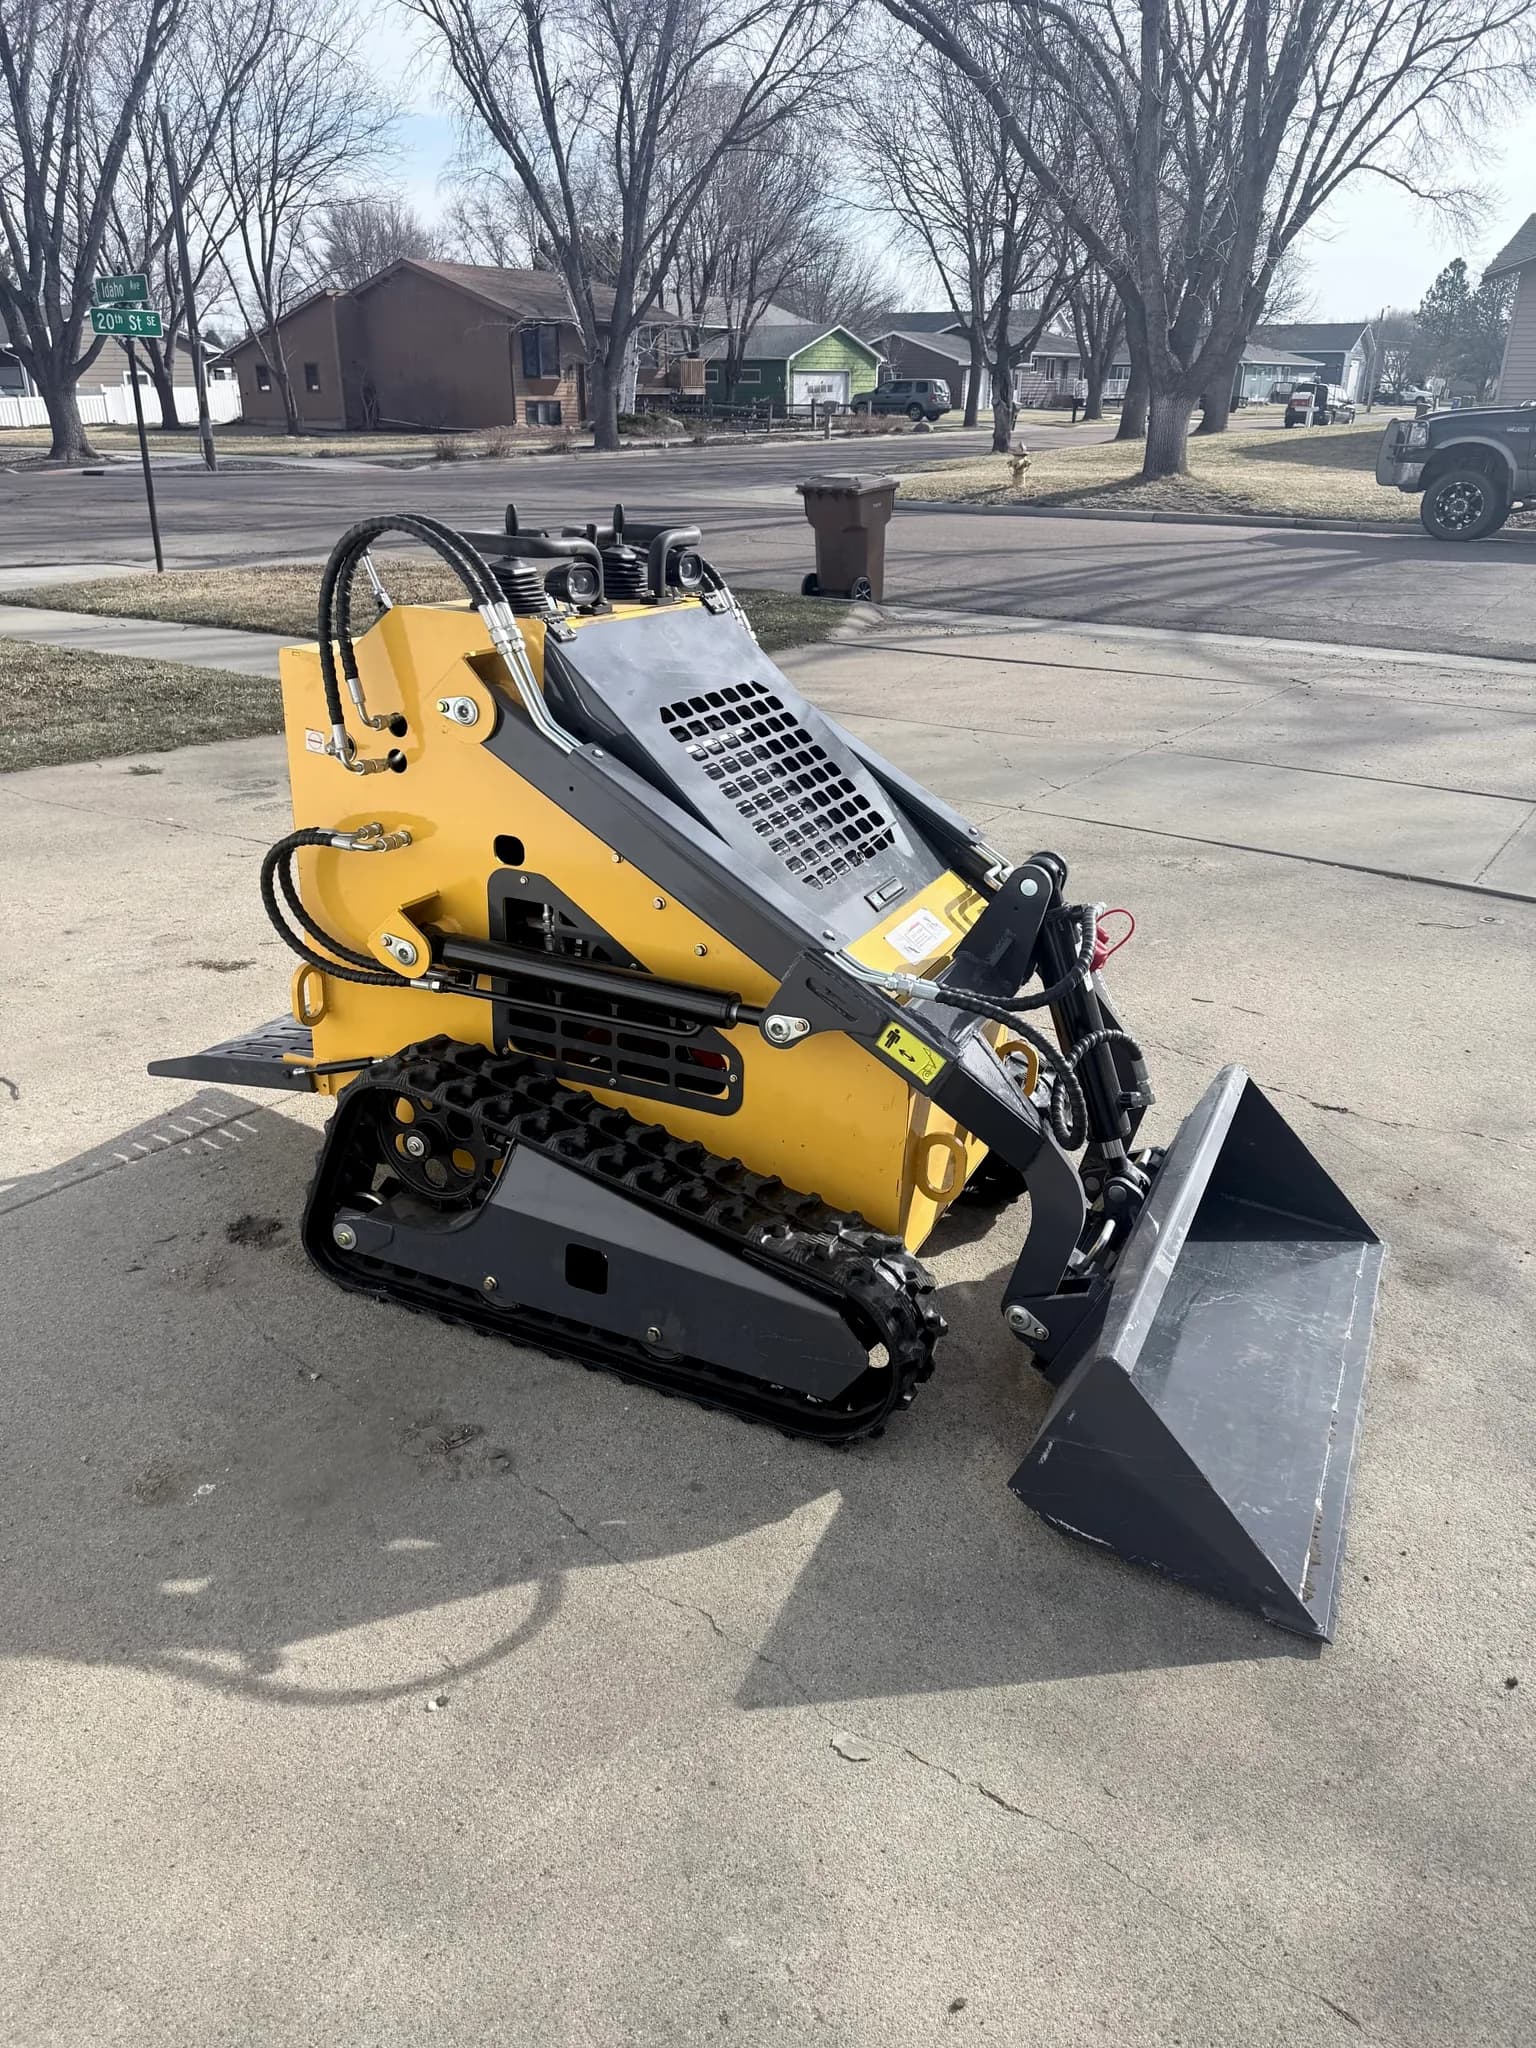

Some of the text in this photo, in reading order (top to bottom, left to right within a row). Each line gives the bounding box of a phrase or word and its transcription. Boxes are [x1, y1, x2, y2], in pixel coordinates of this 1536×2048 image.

[101, 281, 125, 299] Idaho
[96, 312, 157, 331] 20th St SE
